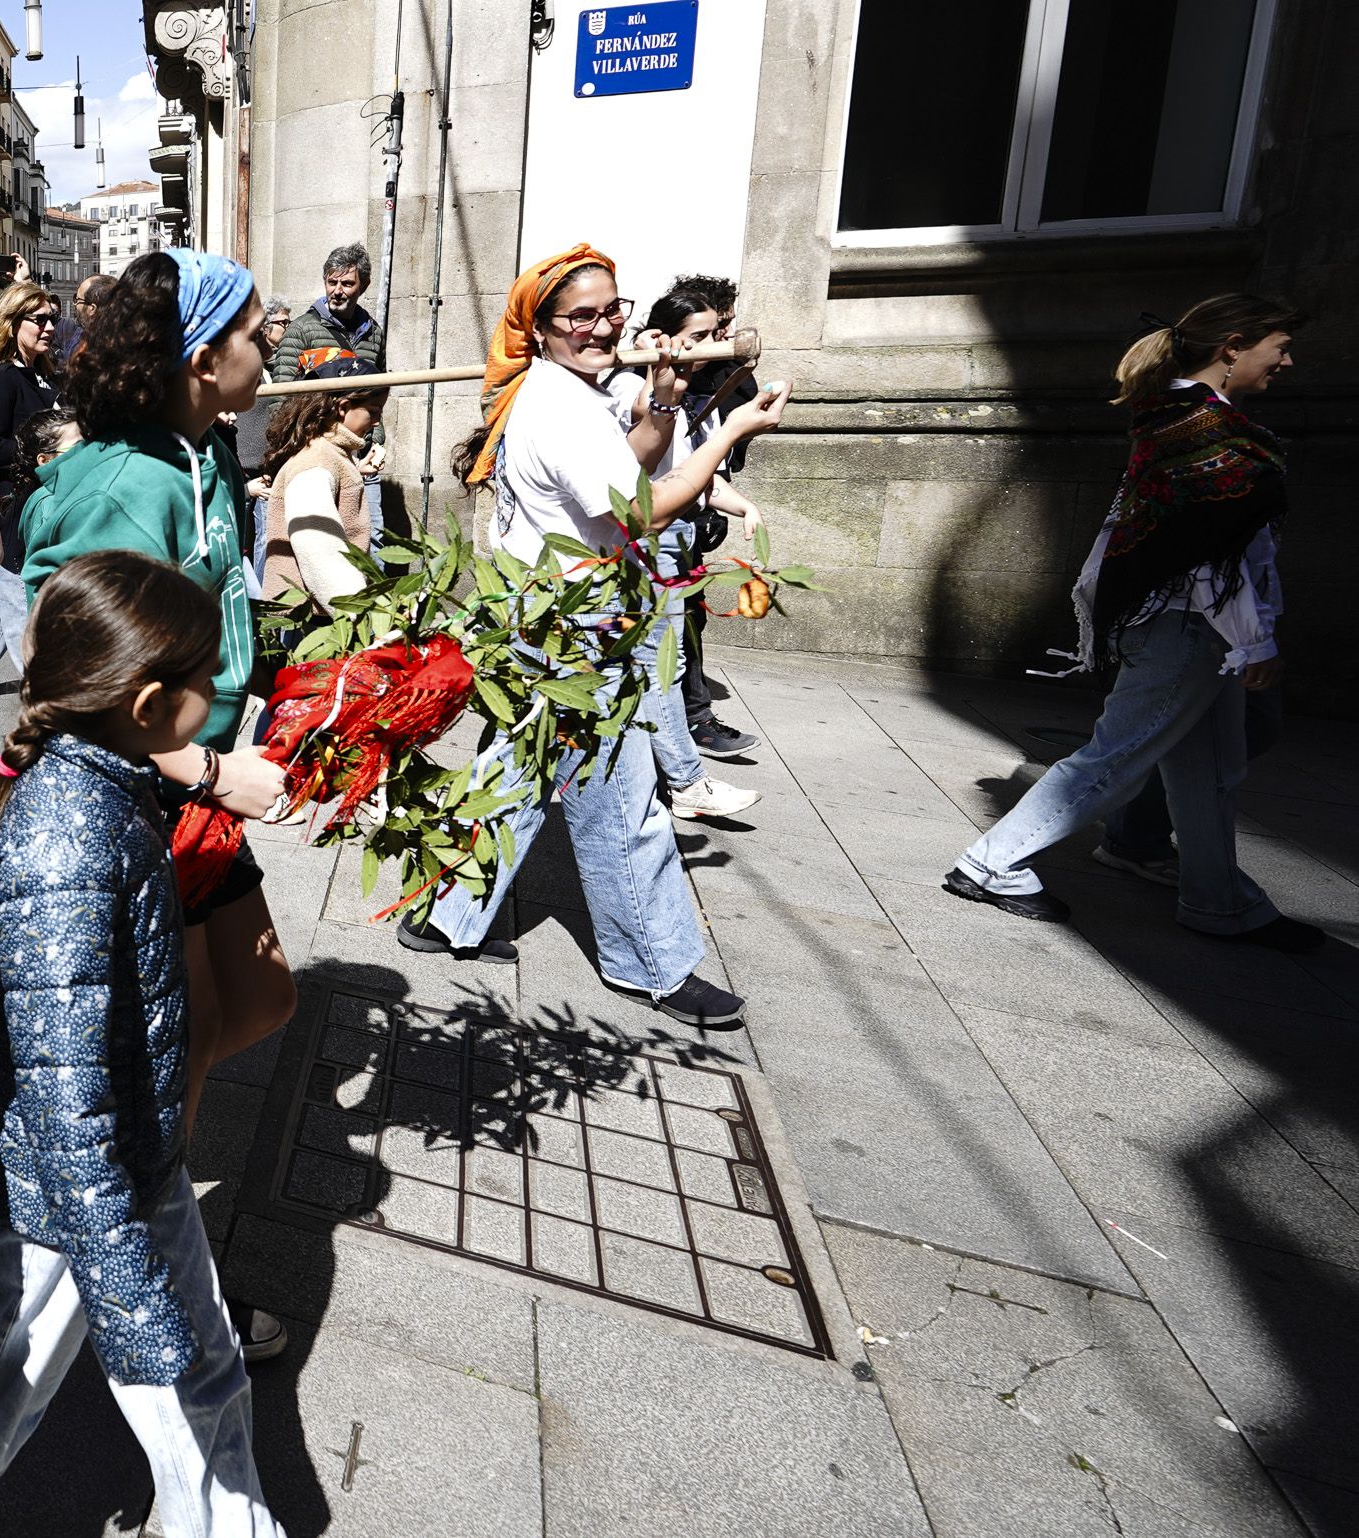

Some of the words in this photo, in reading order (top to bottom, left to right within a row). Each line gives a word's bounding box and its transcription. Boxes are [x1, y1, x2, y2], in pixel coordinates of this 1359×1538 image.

[628, 12, 647, 25] RÚA
[595, 31, 677, 54] FERNÁNDEZ
[592, 53, 678, 75] VILLAVERDE
